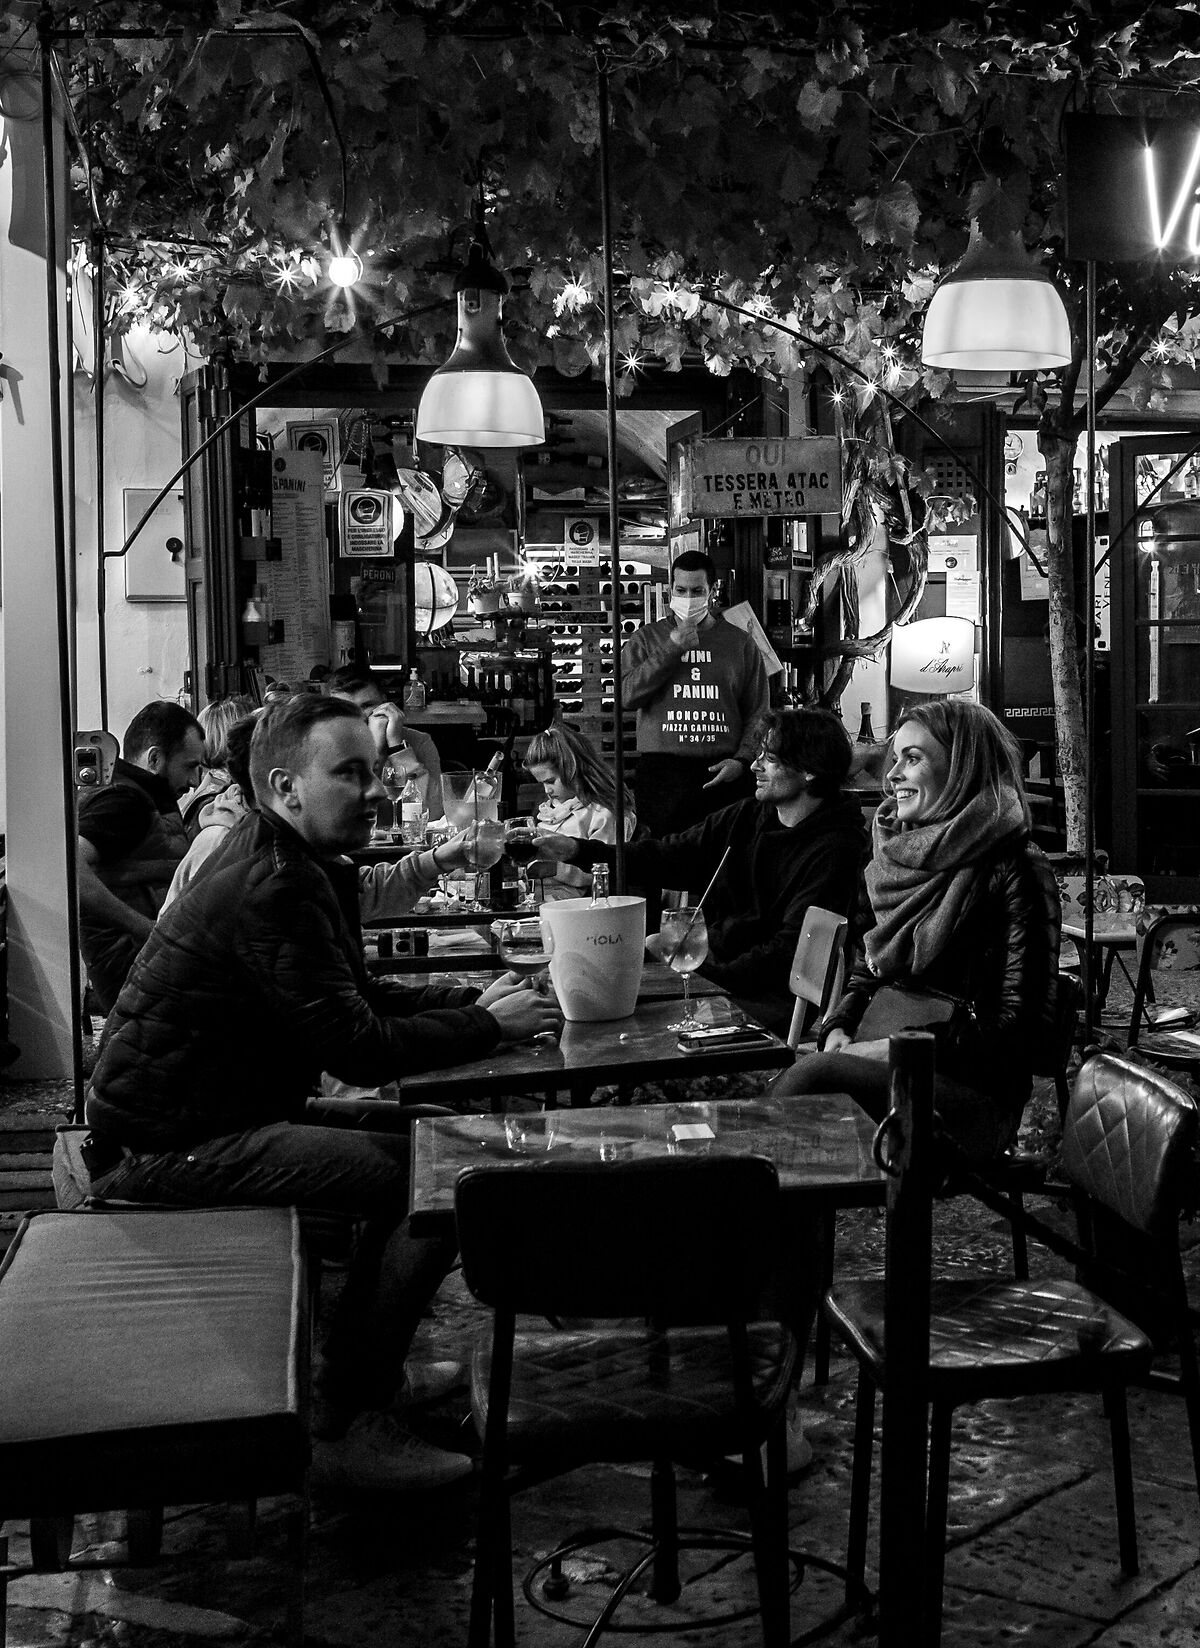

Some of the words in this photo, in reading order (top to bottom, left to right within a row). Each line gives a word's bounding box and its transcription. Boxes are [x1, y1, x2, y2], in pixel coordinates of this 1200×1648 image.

[703, 472, 779, 492] TESSERA
[787, 472, 829, 489] ATAC
[749, 490, 805, 509] METRO
[363, 569, 394, 582] PERONI
[680, 650, 712, 663] VINI
[691, 667, 701, 681] &
[673, 684, 719, 699] PANINI
[667, 710, 725, 721] MONOPOLI
[662, 723, 688, 732] PIAZZA
